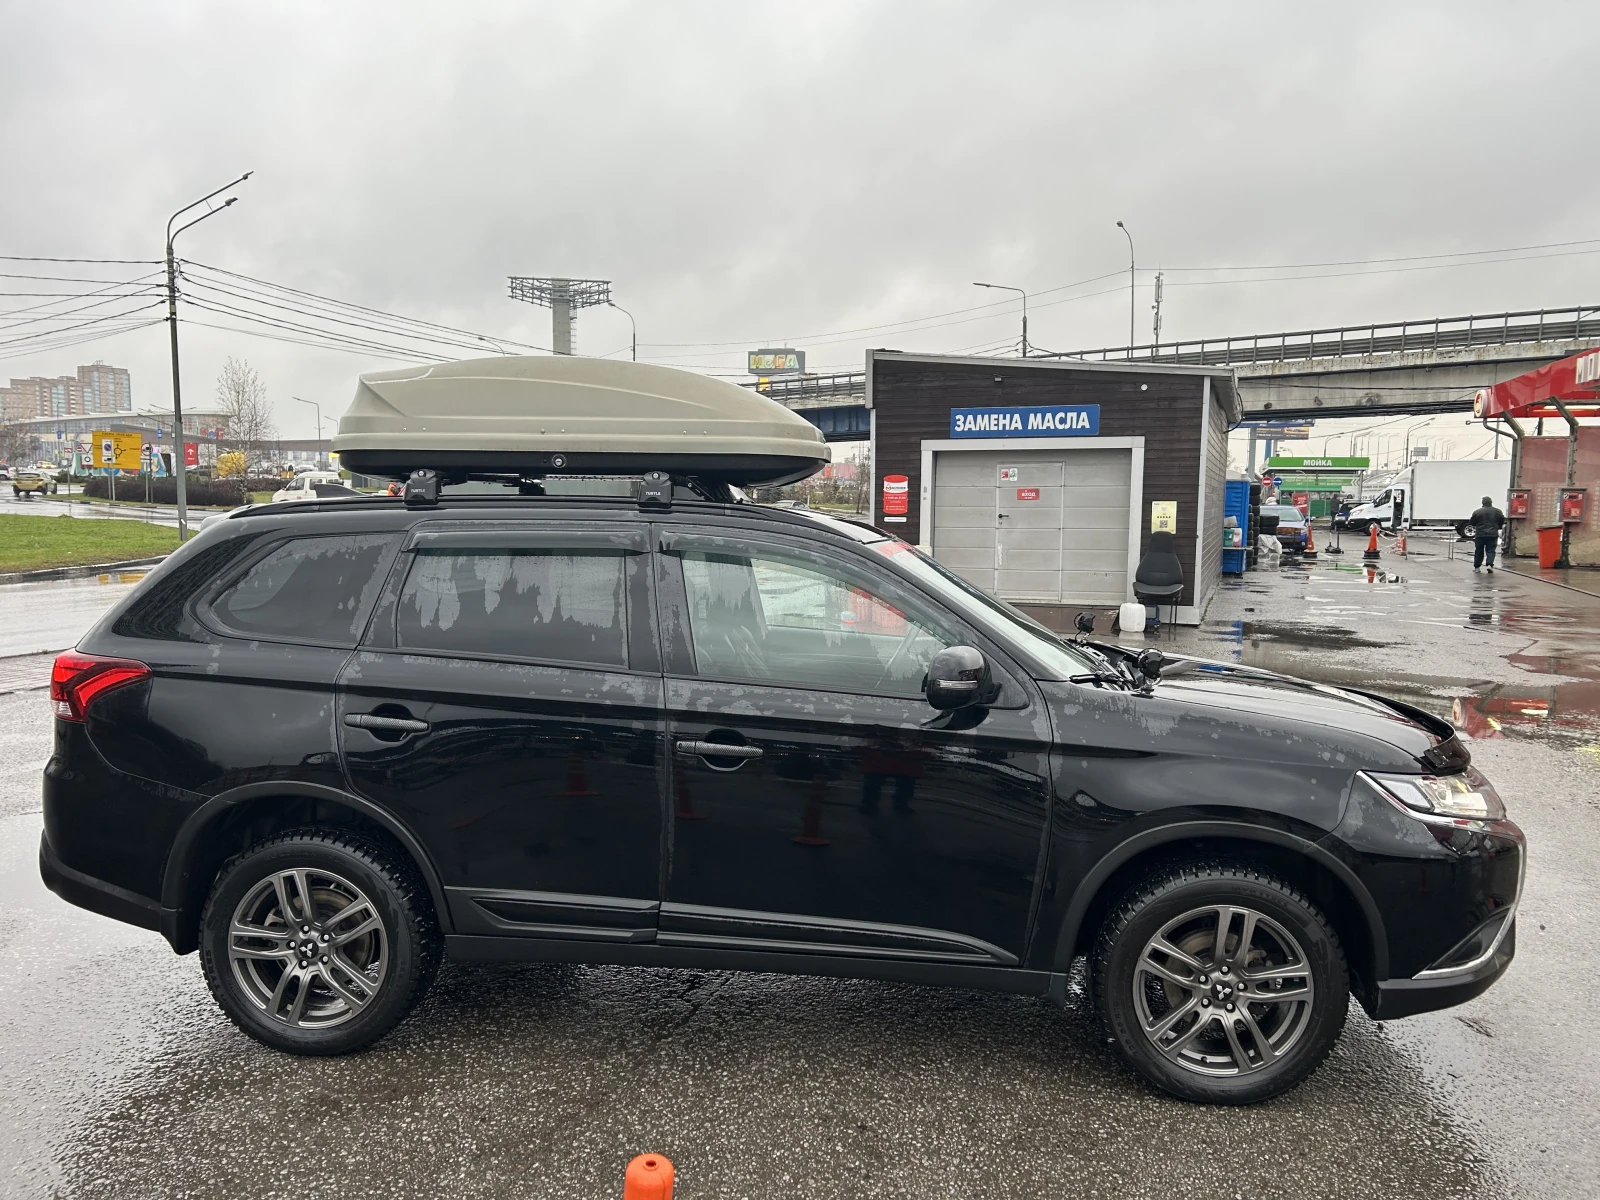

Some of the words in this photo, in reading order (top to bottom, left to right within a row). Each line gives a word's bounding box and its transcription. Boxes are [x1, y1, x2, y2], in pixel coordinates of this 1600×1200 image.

[954, 413, 1023, 432] ЗАМЕНА
[1027, 412, 1090, 430] МАСЛА
[1303, 458, 1332, 466] МОЙКА
